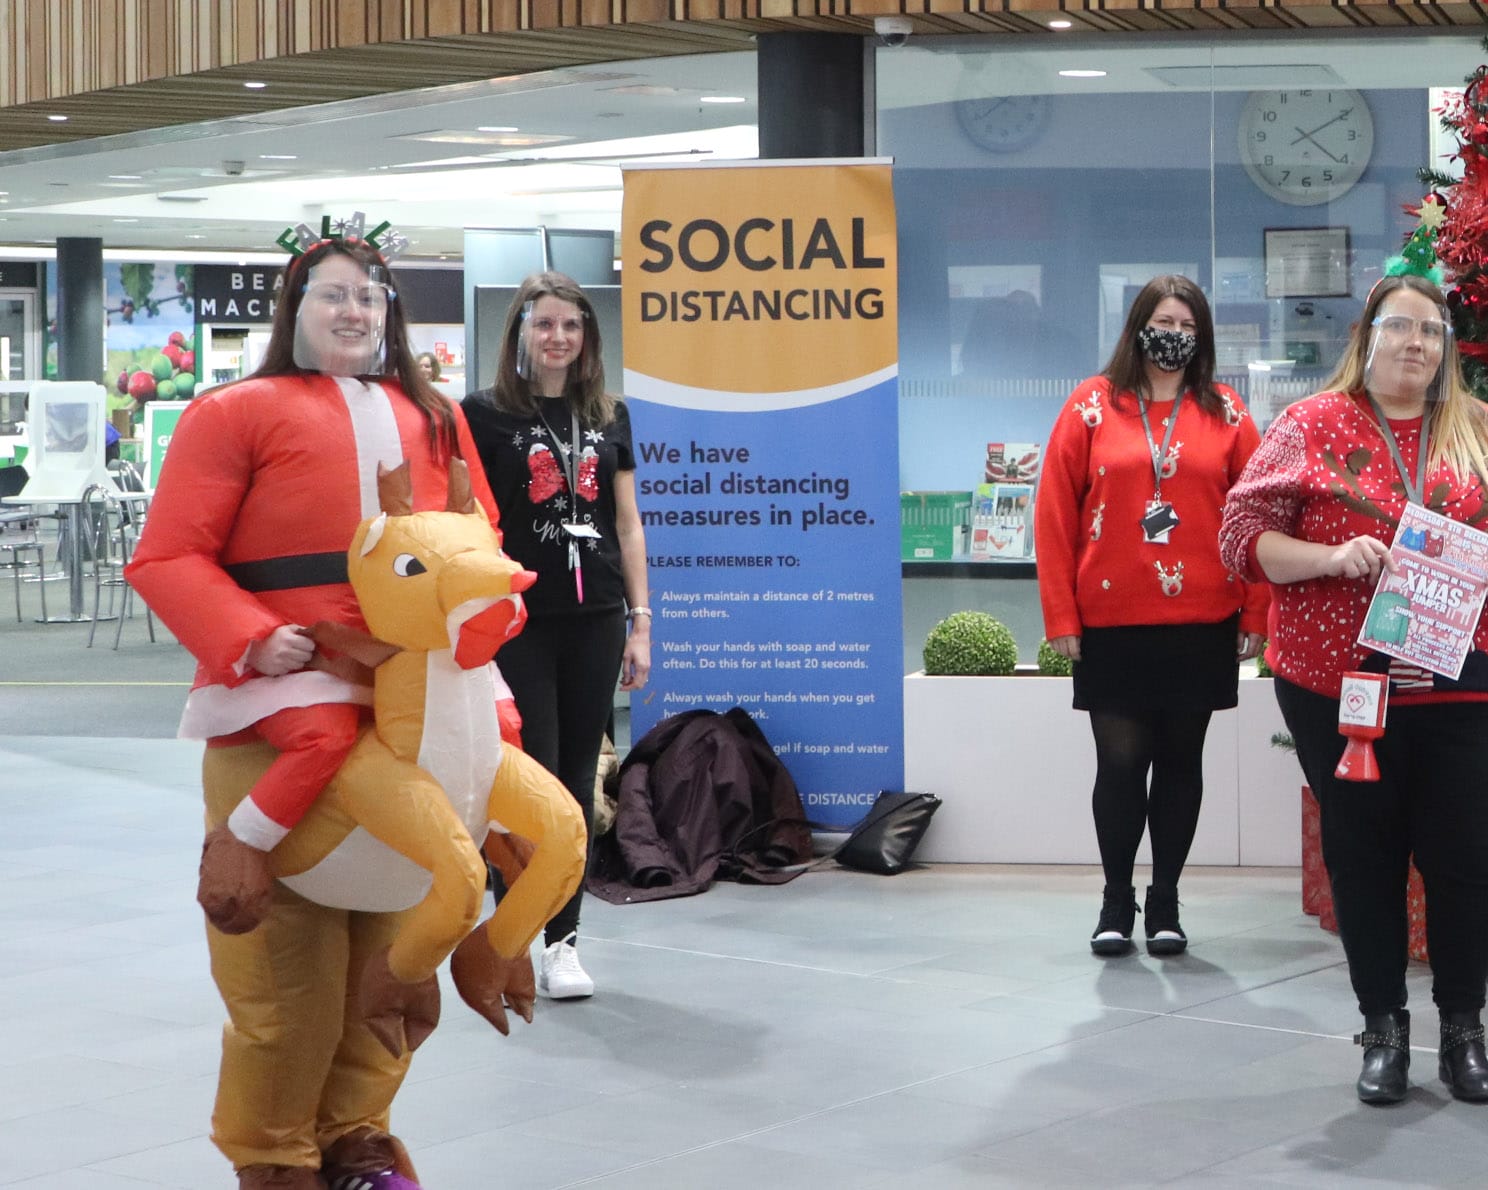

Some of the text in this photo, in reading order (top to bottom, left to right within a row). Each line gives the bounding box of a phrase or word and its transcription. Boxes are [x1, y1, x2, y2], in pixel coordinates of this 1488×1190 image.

[1263, 111, 1277, 122] 10
[1256, 131, 1267, 142] 9
[1347, 130, 1356, 141] 3
[1264, 155, 1274, 166] 8
[1340, 154, 1349, 164] 4
[1281, 171, 1290, 181] 7
[1323, 170, 1333, 181] 5
[1301, 177, 1311, 188] 6
[639, 217, 885, 273] SOCIAL
[231, 273, 284, 290] BEA
[200, 298, 279, 316] MACH
[640, 288, 884, 322] DISTANCING
[639, 441, 750, 464] We have
[640, 472, 849, 500] social distancing
[641, 502, 875, 531] measures in place.
[697, 555, 773, 568] REMEMBER
[778, 555, 800, 568] TO:
[1402, 569, 1464, 609] XMAS
[661, 590, 875, 603] Always maintain a distance of 2 metres
[1411, 594, 1447, 614] JUMPER
[661, 608, 730, 618] from others.
[662, 641, 871, 654] Wash your hands with soap and water
[662, 658, 869, 669] often. Do this for at least 20 seconds.
[663, 692, 875, 705] Always wash your hands when you get
[750, 709, 769, 720] ork.
[773, 743, 889, 756] gel if soap and water
[808, 793, 875, 806] DISTANCE
